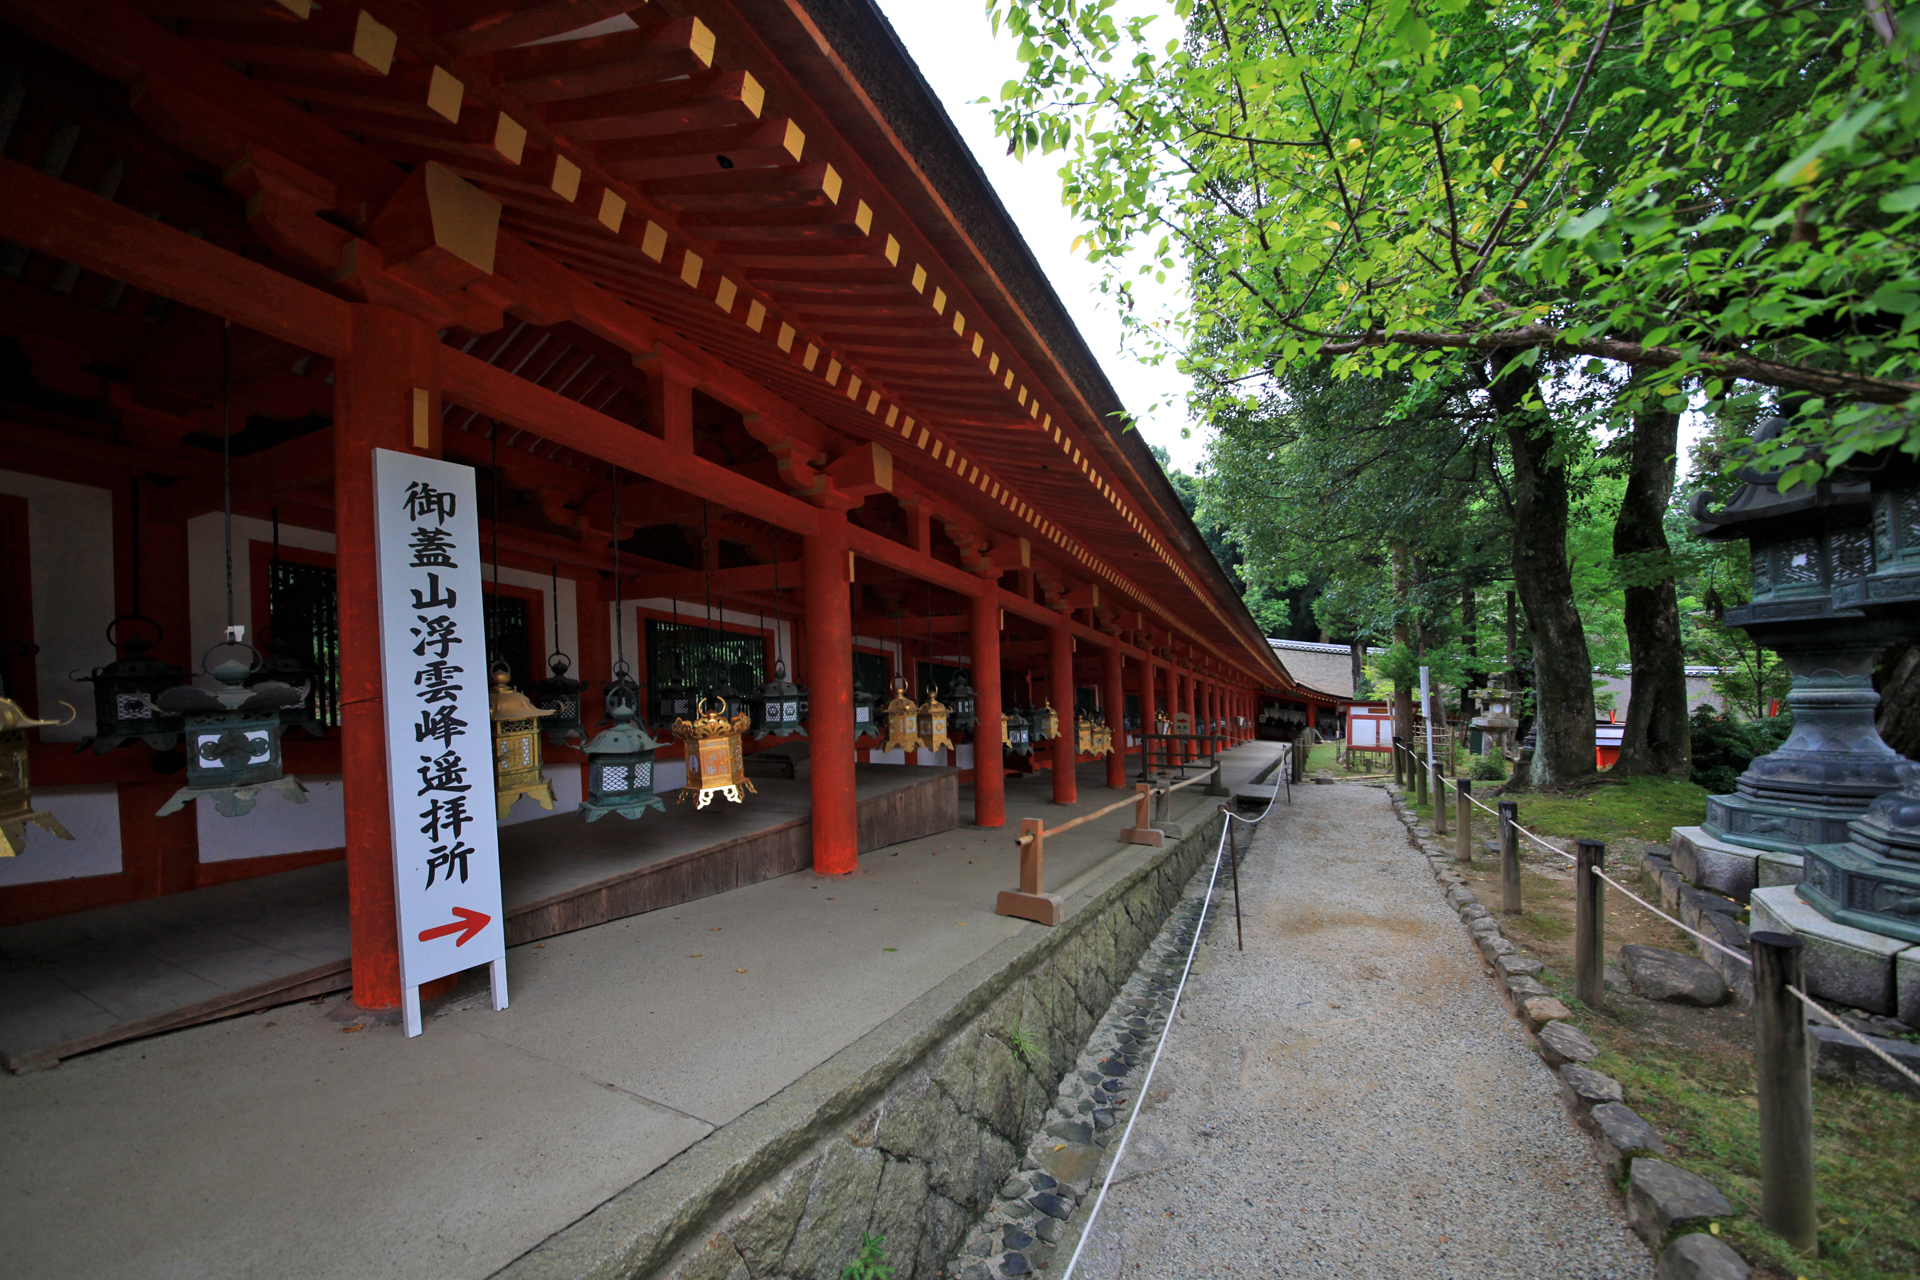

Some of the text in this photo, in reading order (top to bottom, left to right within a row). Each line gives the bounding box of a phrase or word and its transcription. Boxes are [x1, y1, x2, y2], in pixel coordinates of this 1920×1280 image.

[402, 480, 476, 892] 御蓋山浮雲峰遥拝所
